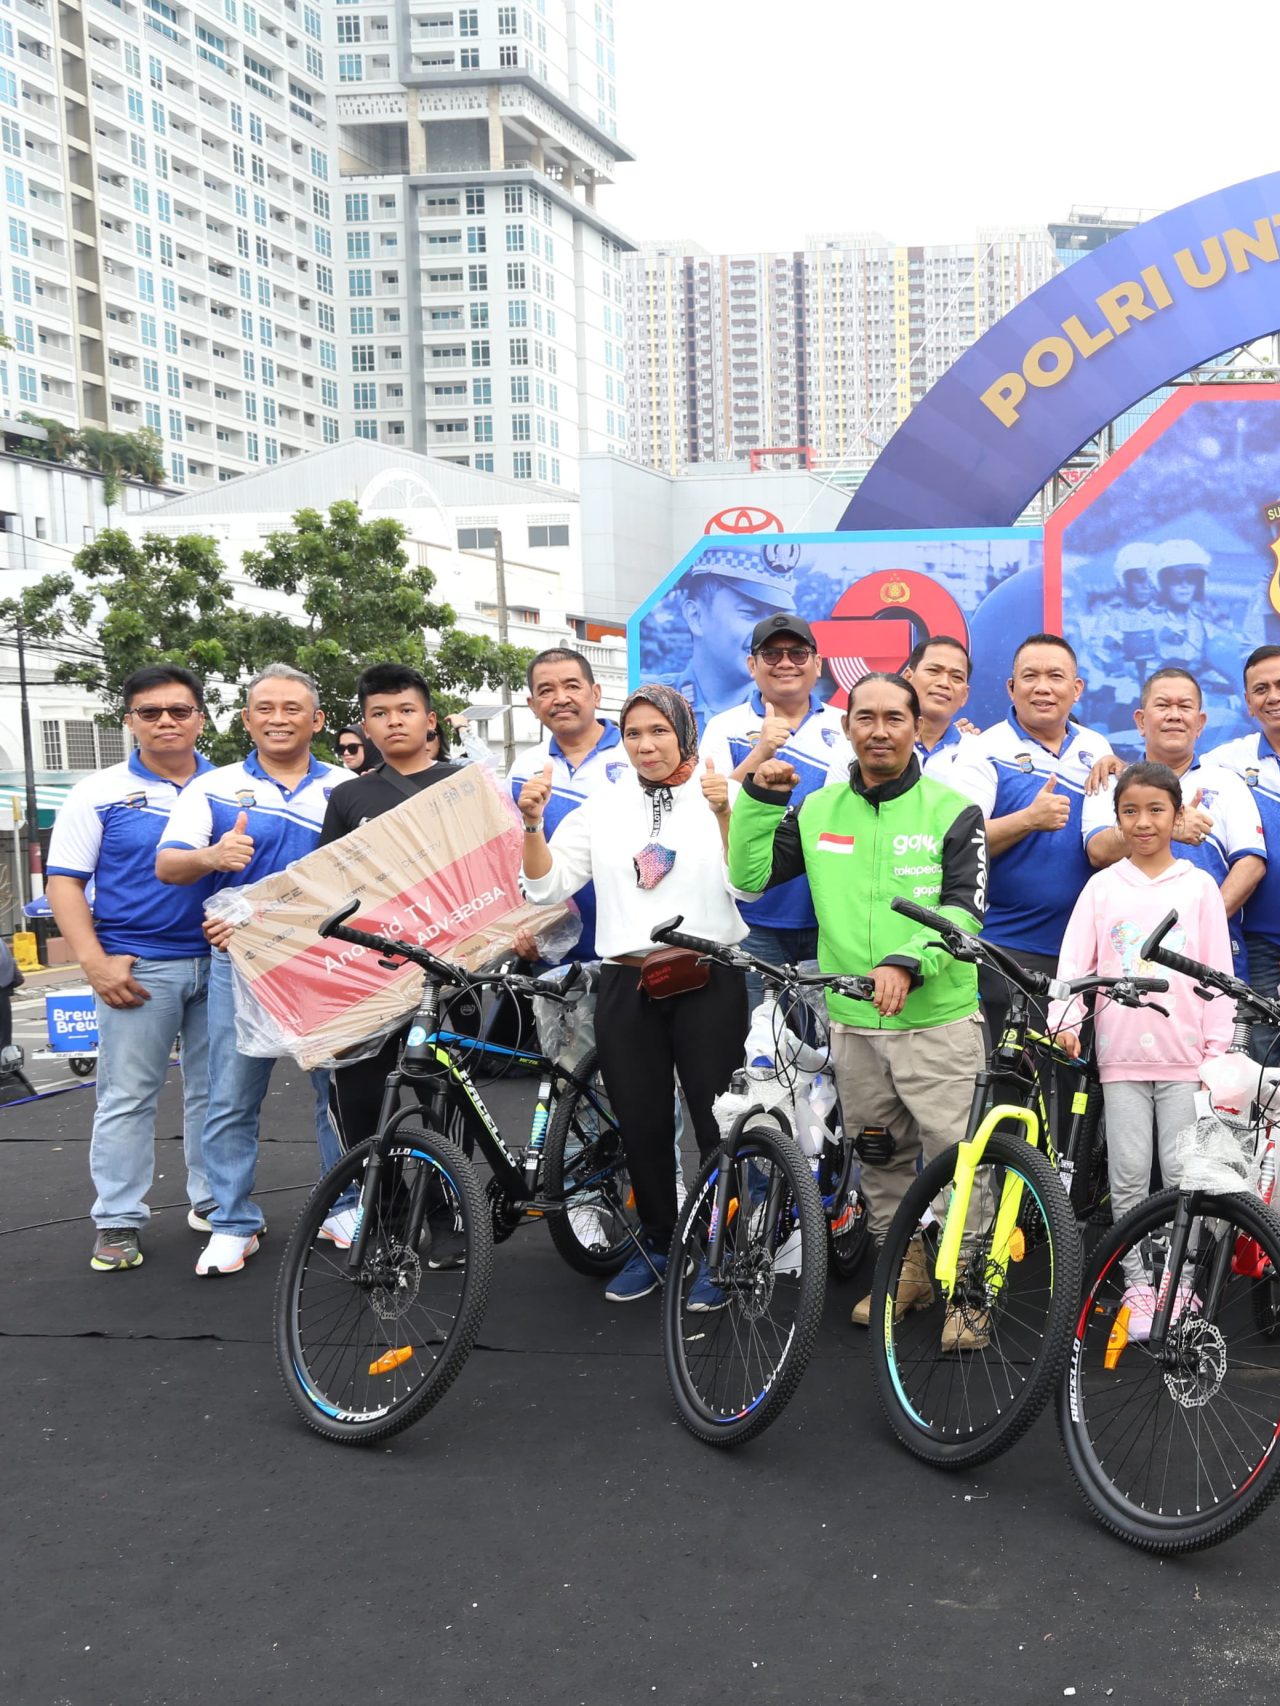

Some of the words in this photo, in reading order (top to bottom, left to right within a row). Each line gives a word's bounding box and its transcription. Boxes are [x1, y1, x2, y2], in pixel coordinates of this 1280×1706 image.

[980, 262, 1174, 428] POLRI
[404, 895, 436, 922] TV
[416, 885, 507, 946] ADV-3203A
